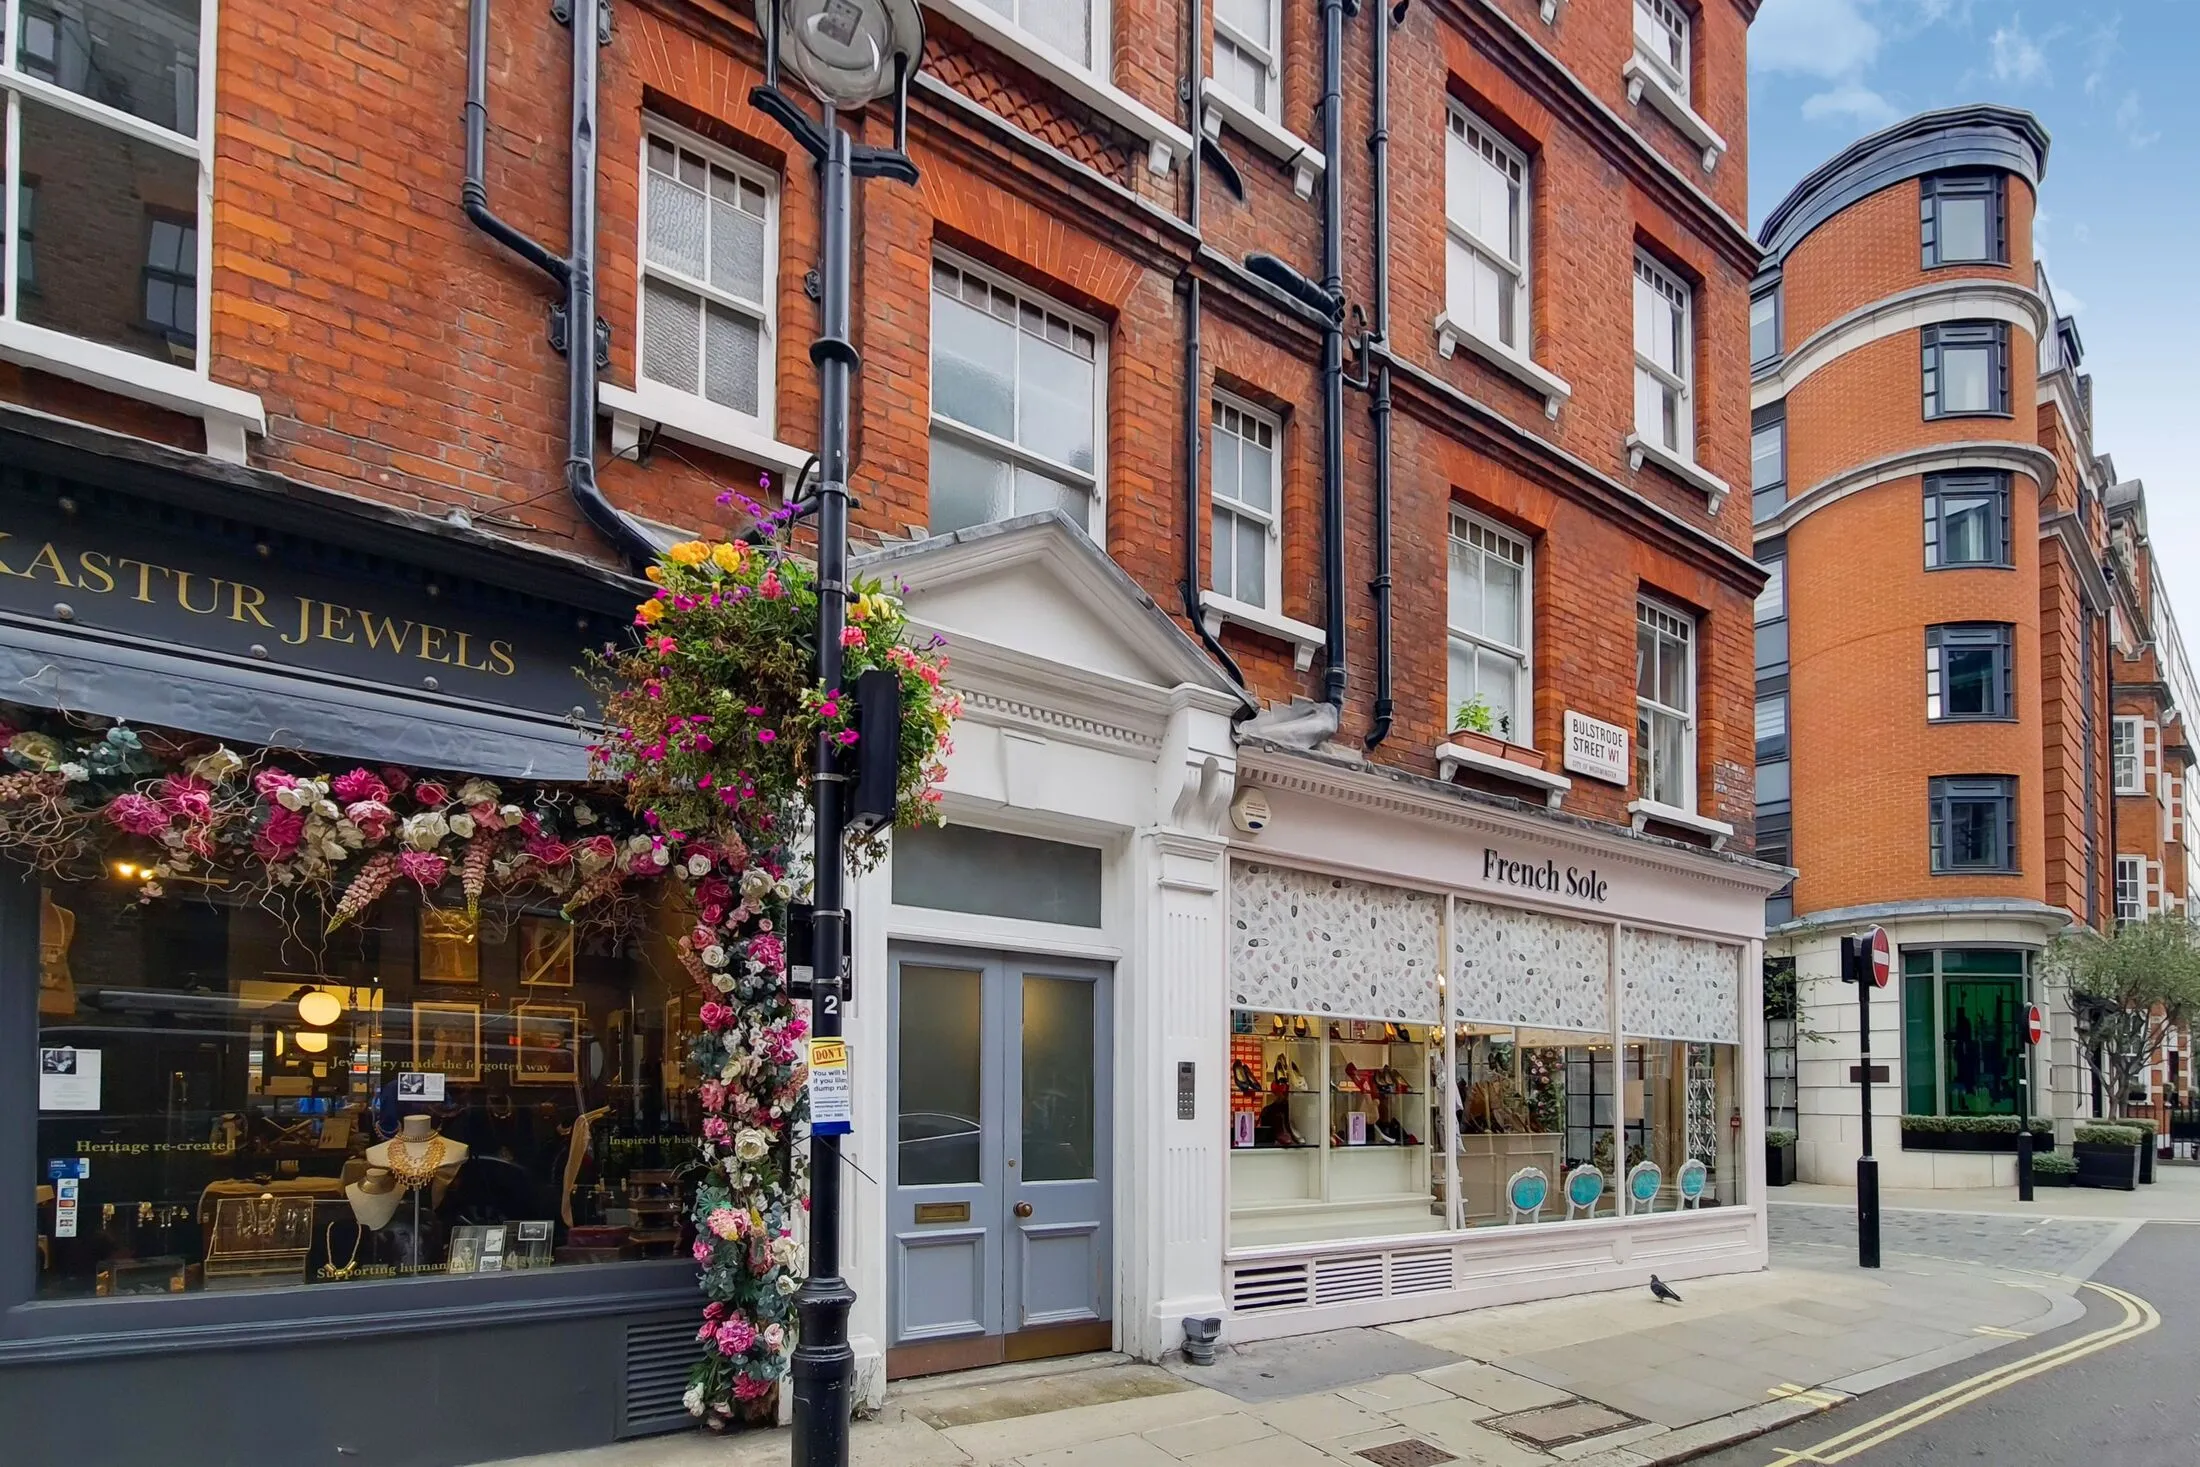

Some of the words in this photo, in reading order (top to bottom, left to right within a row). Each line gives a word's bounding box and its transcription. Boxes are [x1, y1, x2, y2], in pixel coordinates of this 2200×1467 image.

[279, 596, 516, 676] JEWELS
[1573, 718, 1623, 748] BULSTRODE
[1573, 736, 1605, 759] STREET
[1608, 747, 1620, 764] W1
[1483, 847, 1560, 892] French
[1566, 866, 1608, 902] Sole
[823, 994, 838, 1015] 2
[442, 1059, 462, 1070] the
[465, 1060, 523, 1072] forgotten
[526, 1063, 551, 1073] way
[76, 1140, 150, 1155] Heritage
[154, 1139, 236, 1151] re-created
[609, 1135, 656, 1148] Inspired
[659, 1135, 673, 1147] by
